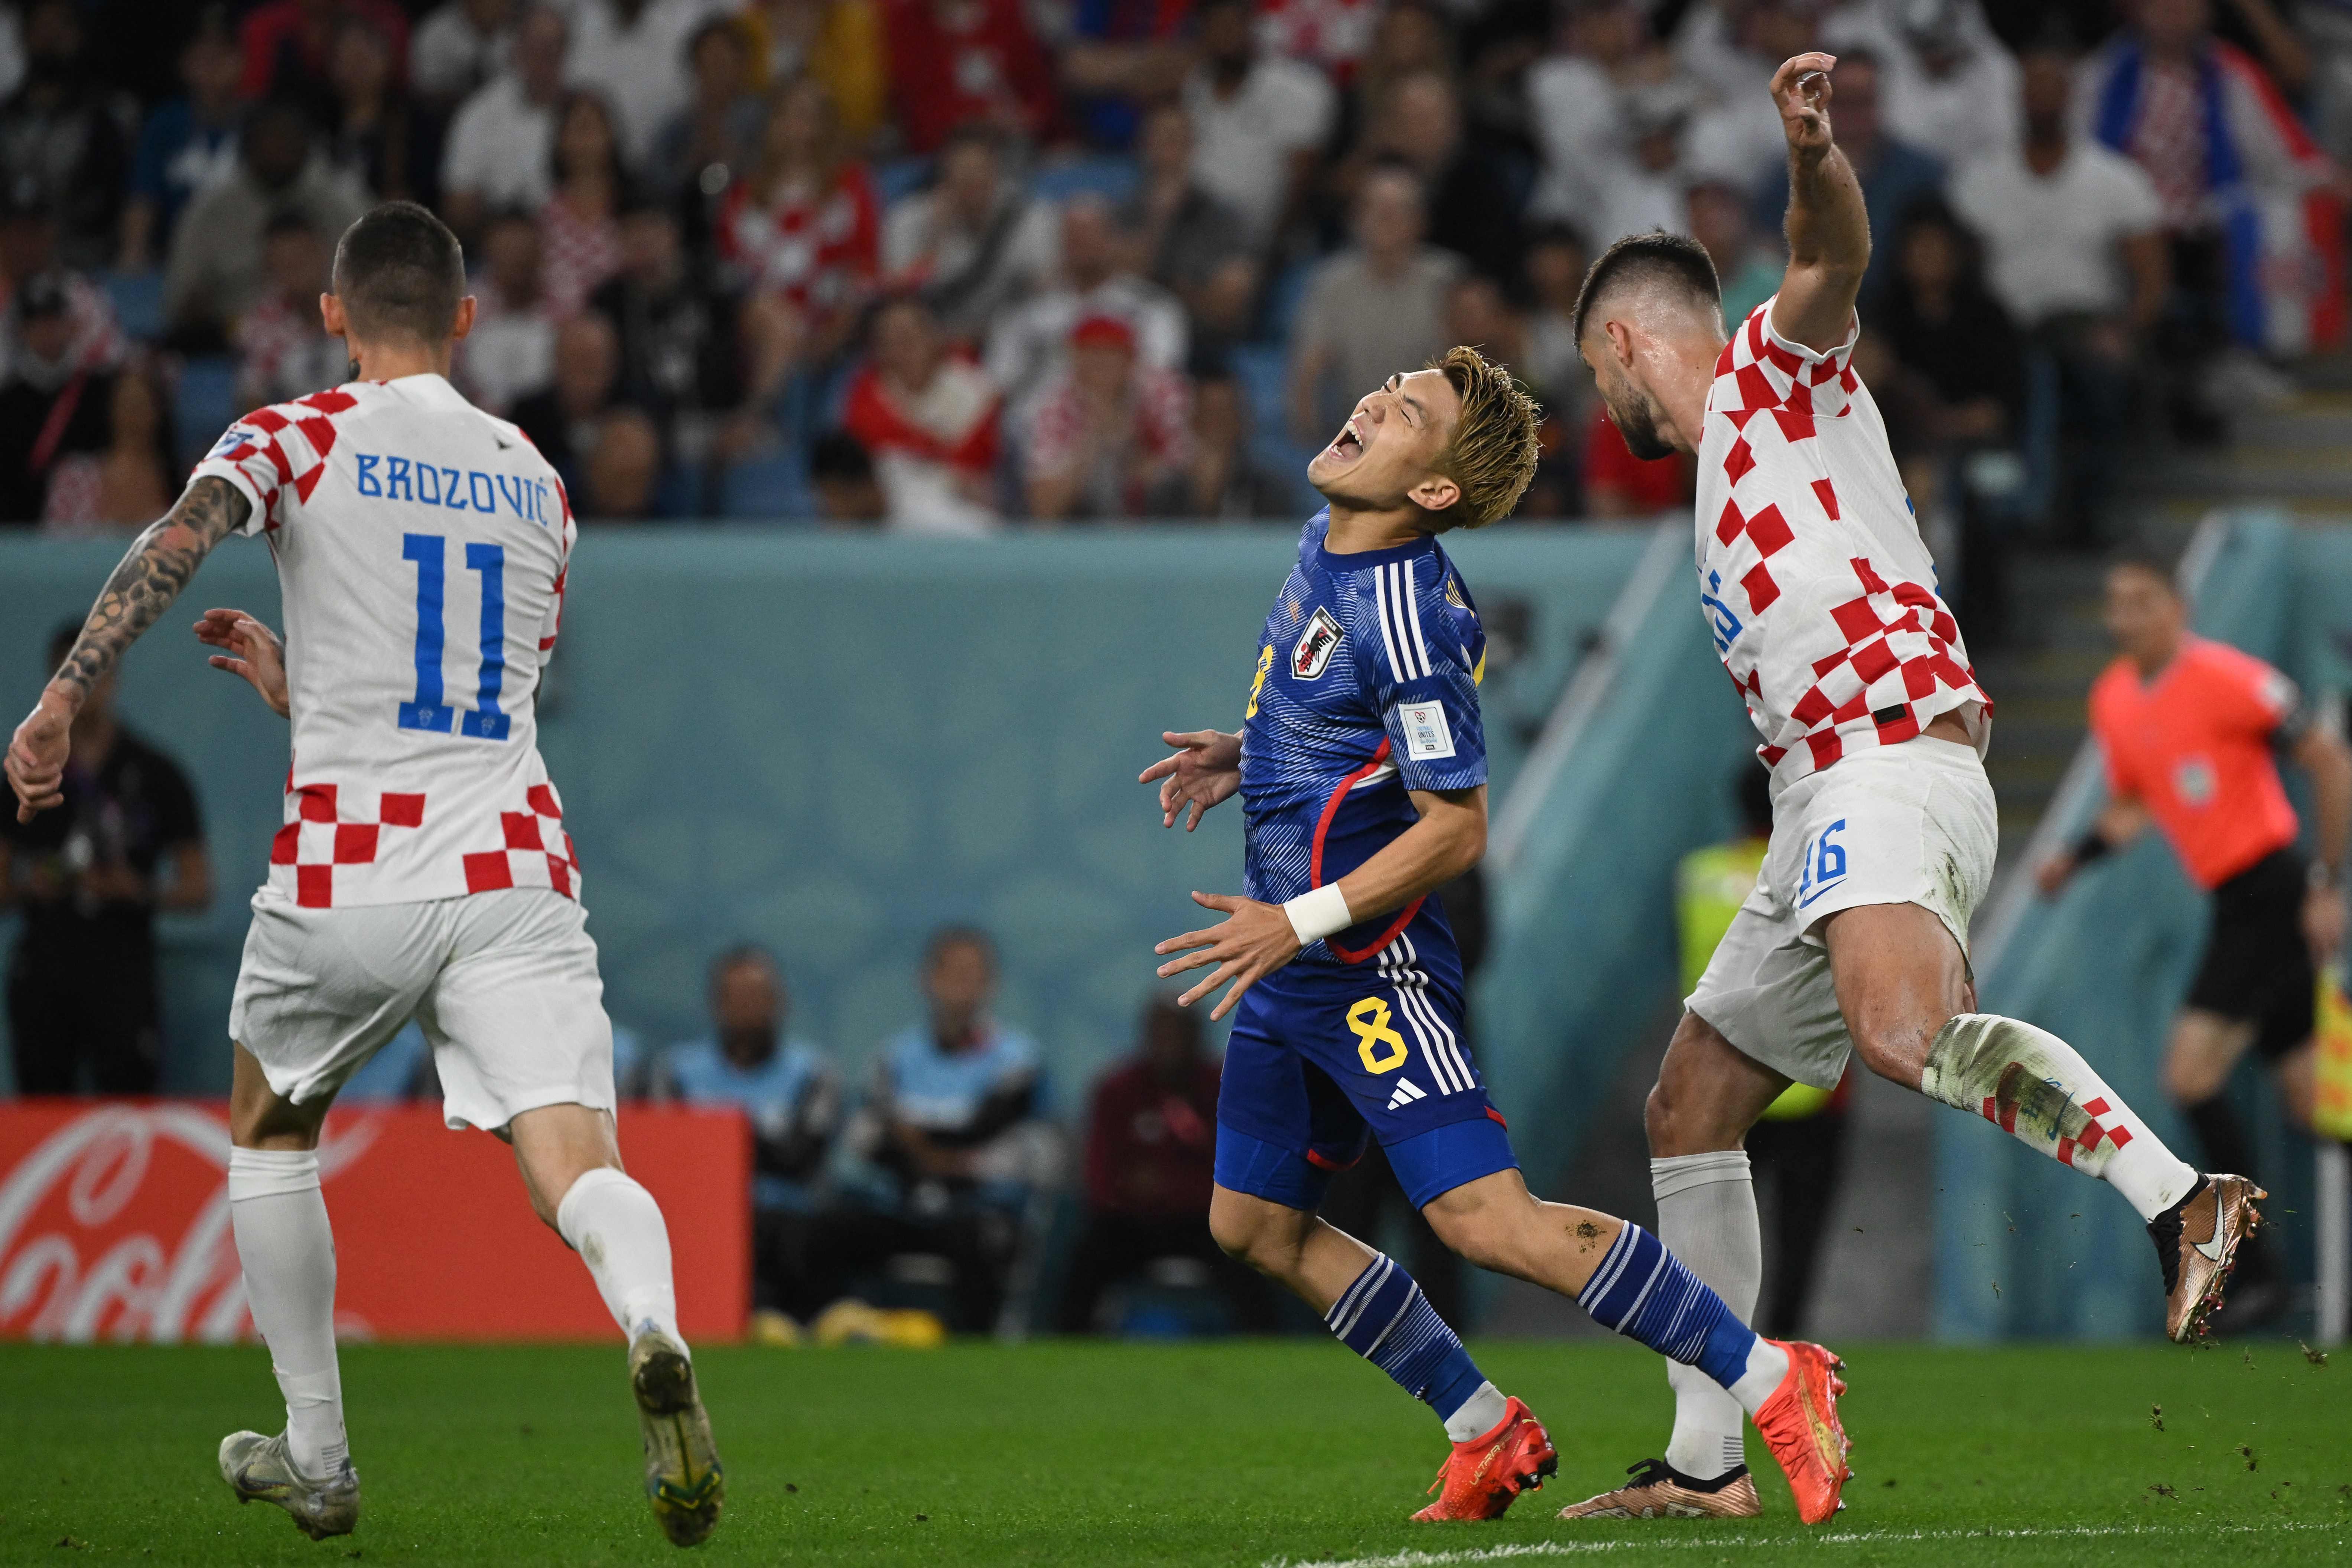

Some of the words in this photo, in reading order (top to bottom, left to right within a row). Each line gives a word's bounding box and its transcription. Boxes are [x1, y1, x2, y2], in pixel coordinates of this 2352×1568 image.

[355, 453, 548, 526] BROZOVIĆ
[398, 533, 511, 741] 11
[1321, 615, 1338, 632] JAPAN
[1799, 818, 1846, 896] 16
[1346, 996, 1408, 1075] 8
[1469, 1445, 1502, 1485] ULTRA
